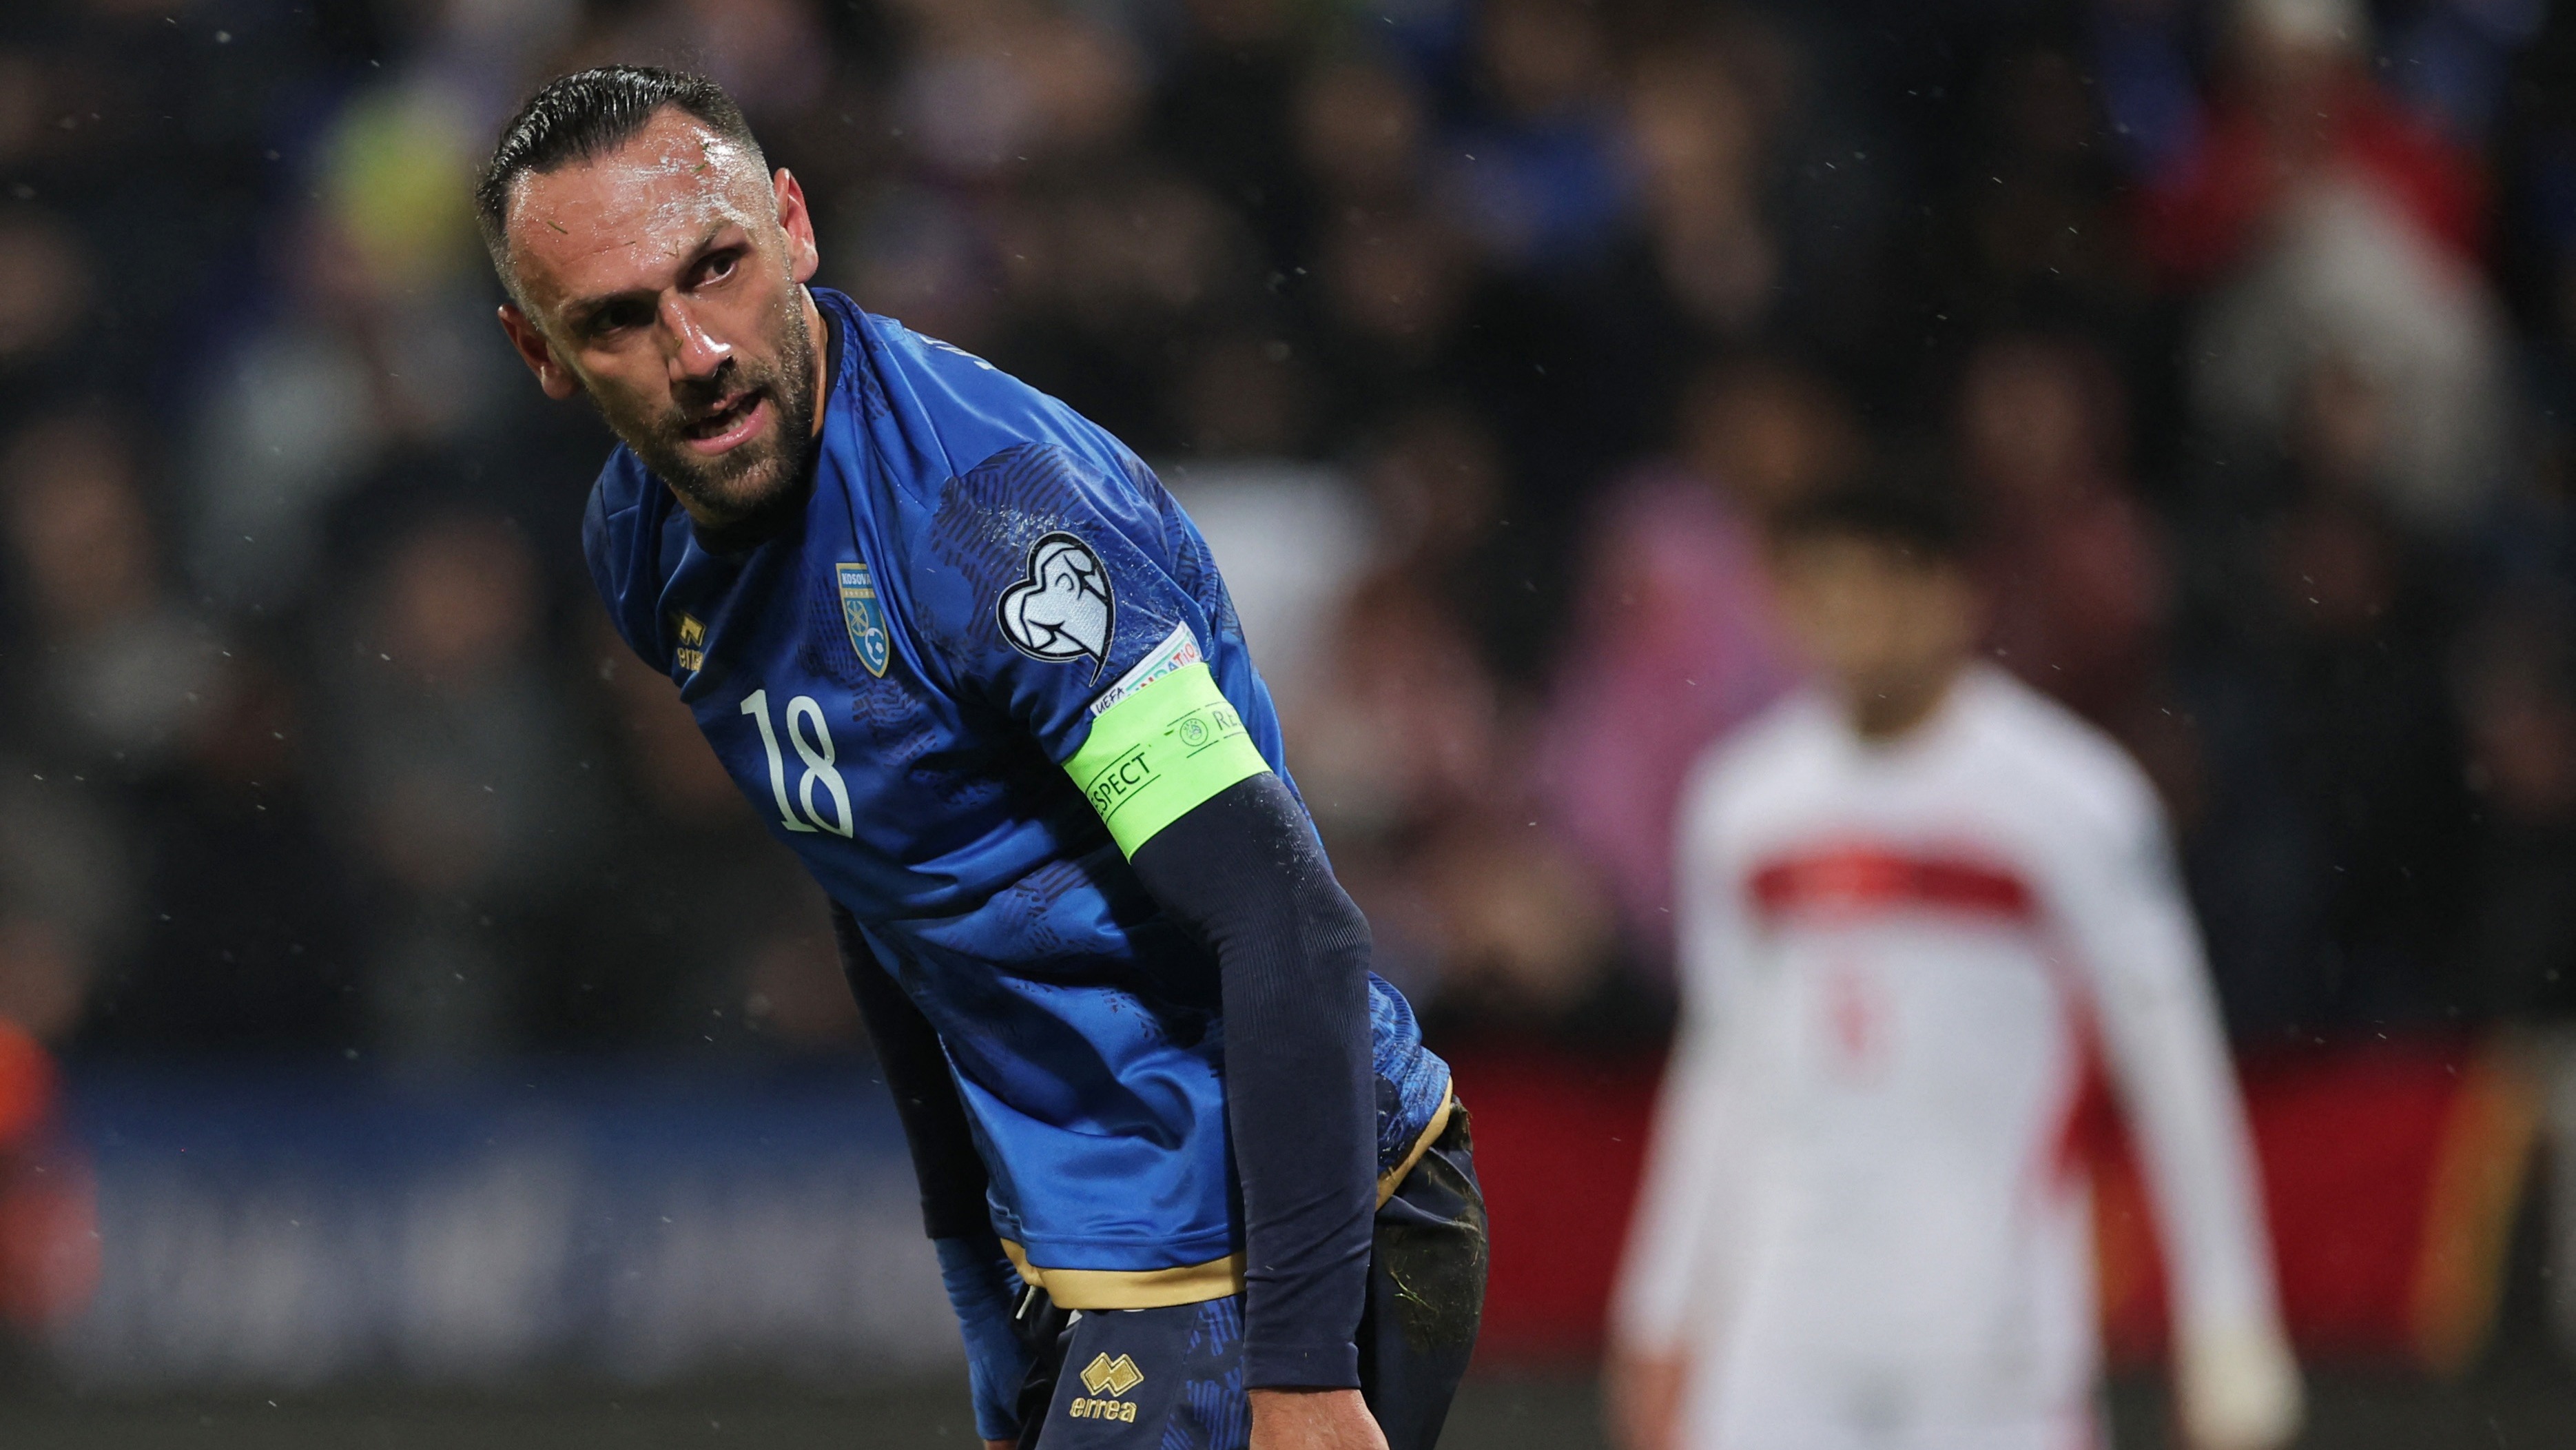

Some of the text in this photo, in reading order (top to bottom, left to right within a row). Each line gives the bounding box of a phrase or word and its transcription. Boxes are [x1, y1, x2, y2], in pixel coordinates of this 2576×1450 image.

[1096, 687, 1124, 714] UEFA
[740, 689, 854, 839] 18
[1091, 752, 1150, 816] ESPECT
[1069, 1397, 1137, 1423] errea
